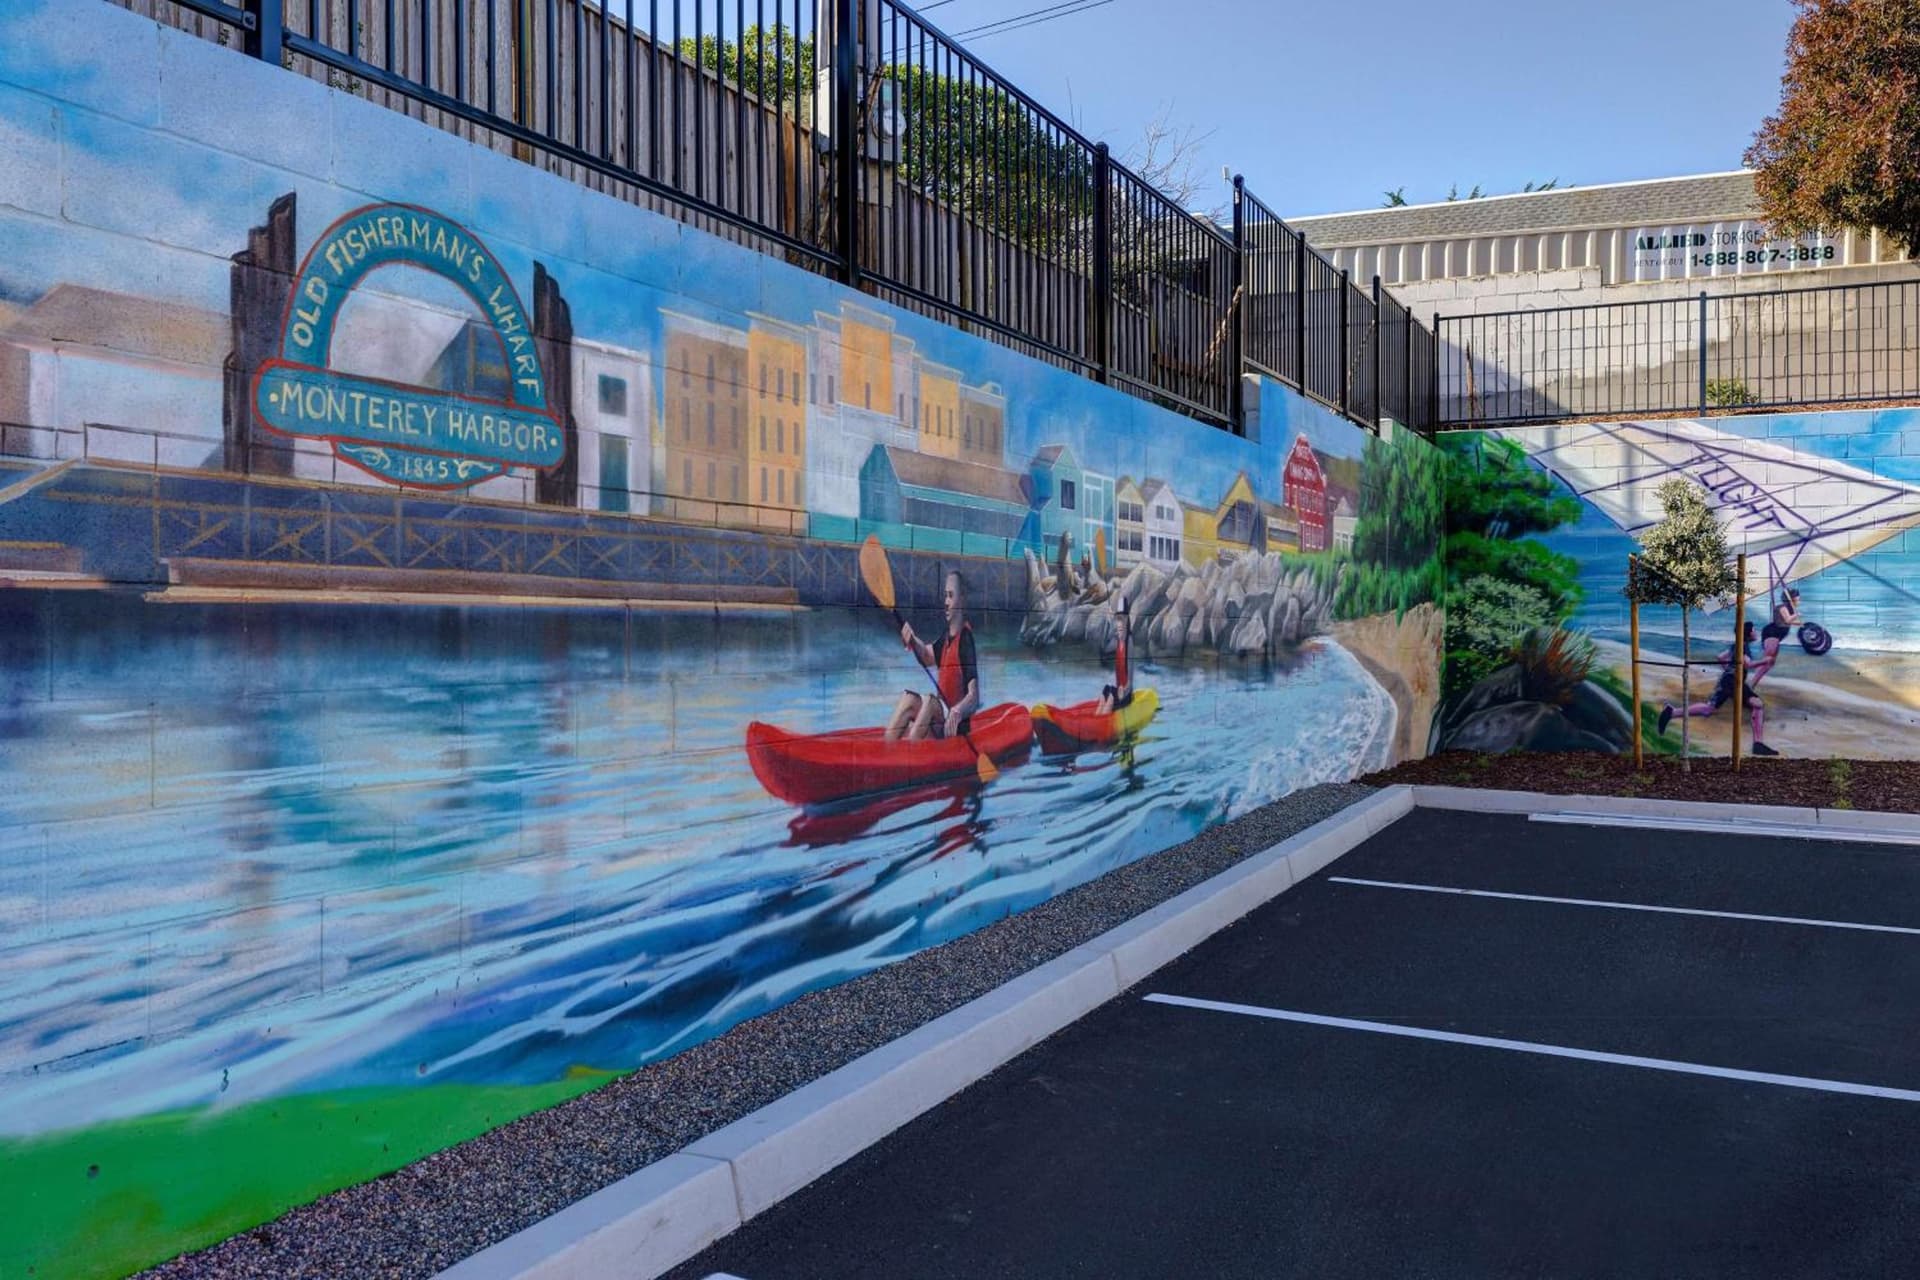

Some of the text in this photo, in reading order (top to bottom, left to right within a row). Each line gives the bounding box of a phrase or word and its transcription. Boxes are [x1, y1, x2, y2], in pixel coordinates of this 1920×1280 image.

[1634, 233, 1707, 250] ALLIED
[1709, 229, 1761, 246] STORAGE
[1691, 245, 1834, 267] 1-888-807-3888
[292, 216, 540, 398] OLD FISHERMAN'S WHARF
[281, 381, 548, 451] MONTEREY HARBOR
[404, 457, 449, 479] 1845
